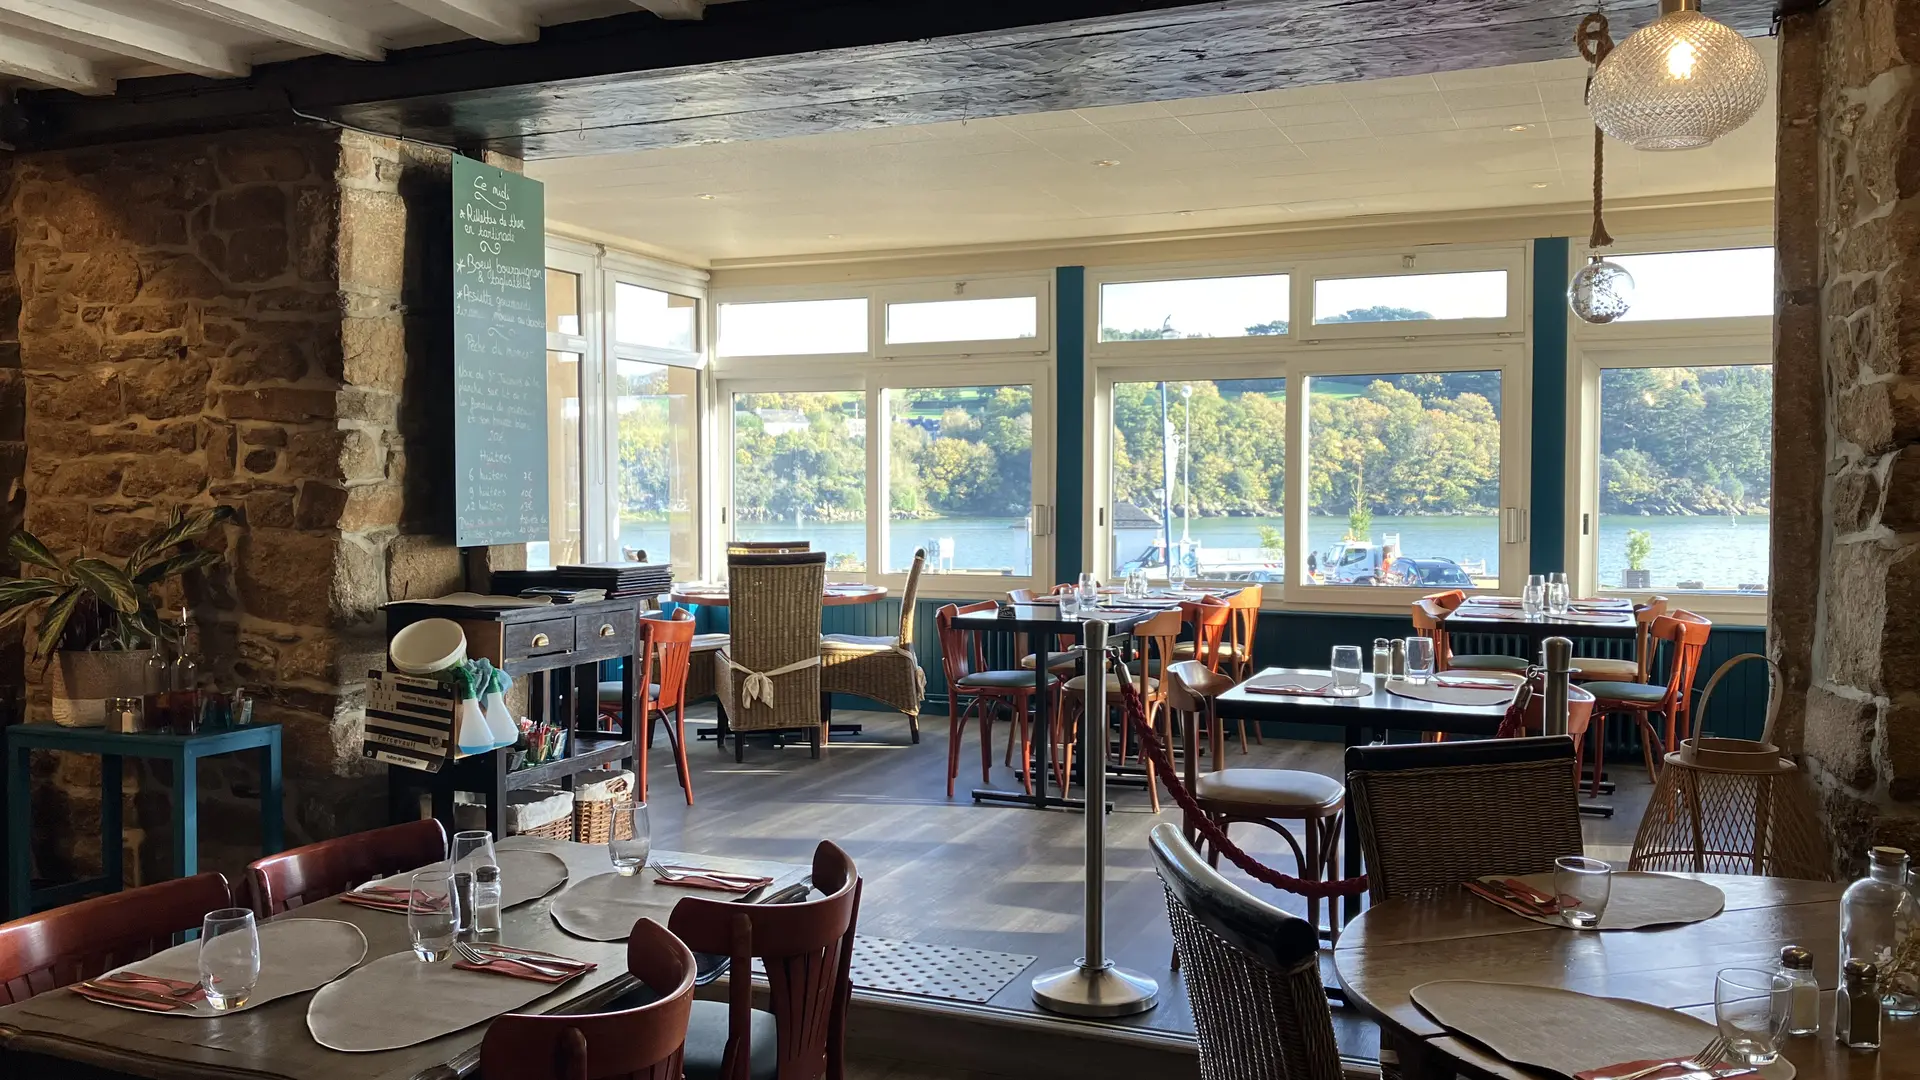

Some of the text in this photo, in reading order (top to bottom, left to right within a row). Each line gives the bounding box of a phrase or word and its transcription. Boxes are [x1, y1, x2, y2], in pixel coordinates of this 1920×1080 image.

[474, 175, 510, 201] Ce midi
[464, 224, 475, 235] en
[468, 467, 475, 482] 6
[468, 486, 475, 500] 9
[464, 501, 476, 512] 12
